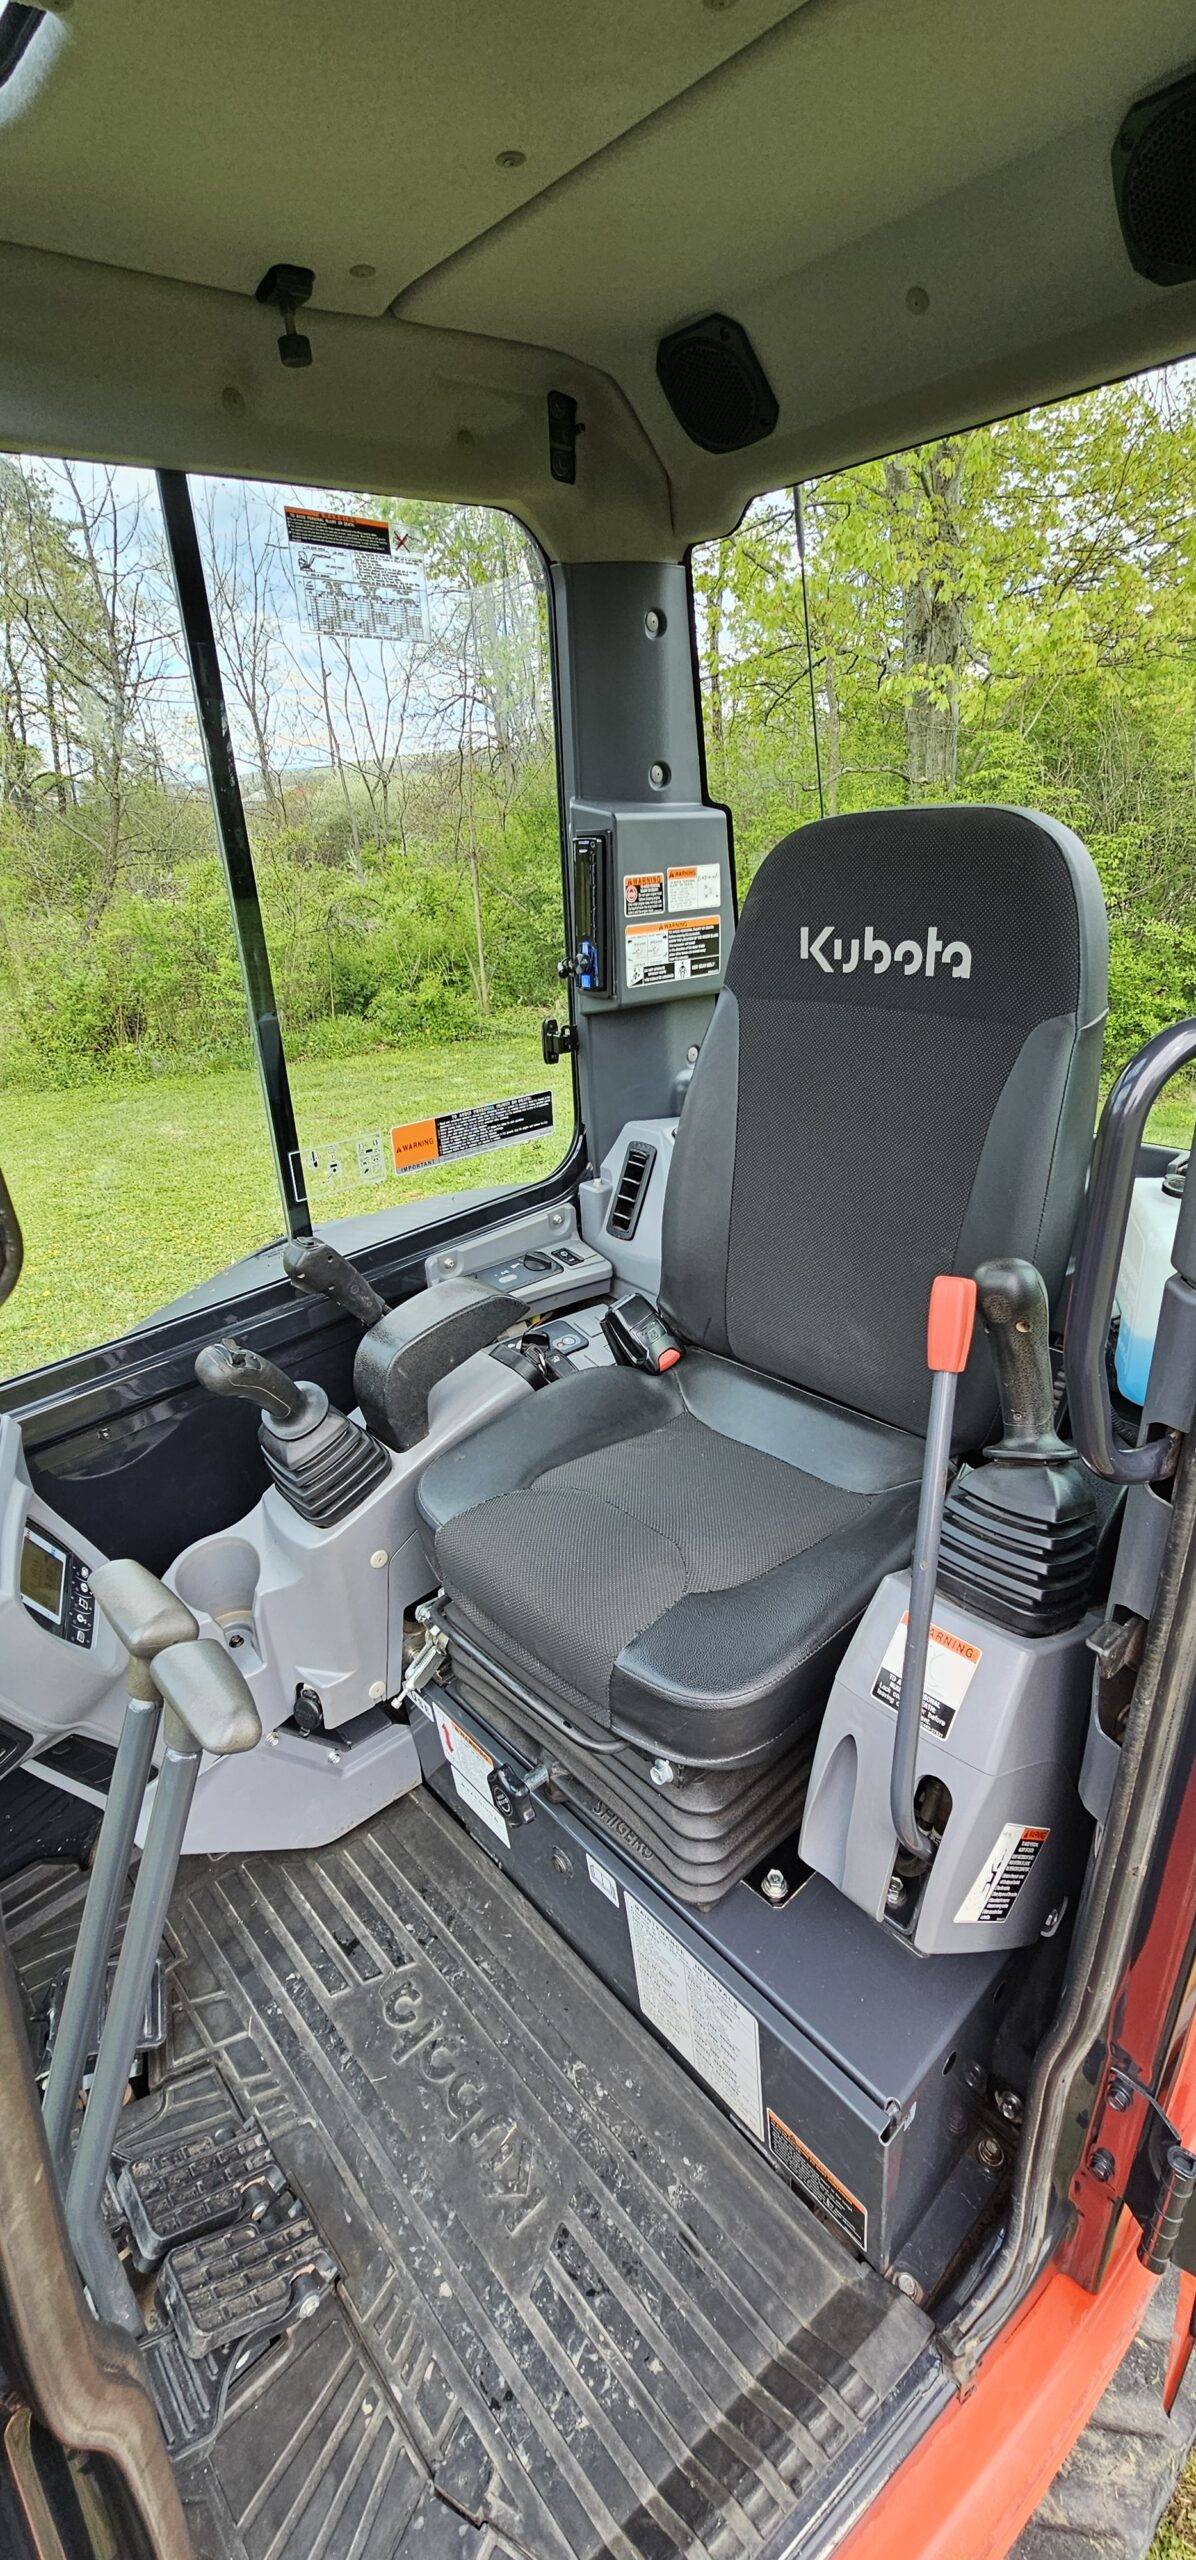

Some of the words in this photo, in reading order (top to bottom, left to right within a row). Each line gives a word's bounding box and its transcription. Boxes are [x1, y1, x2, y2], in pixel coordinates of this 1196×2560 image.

[801, 927, 972, 979] Kubota
[403, 1137, 434, 1151] WARNING
[400, 1160, 436, 1172] IMPORTANT
[929, 1628, 974, 1659] ARNING
[383, 1980, 547, 2237] Kubota
